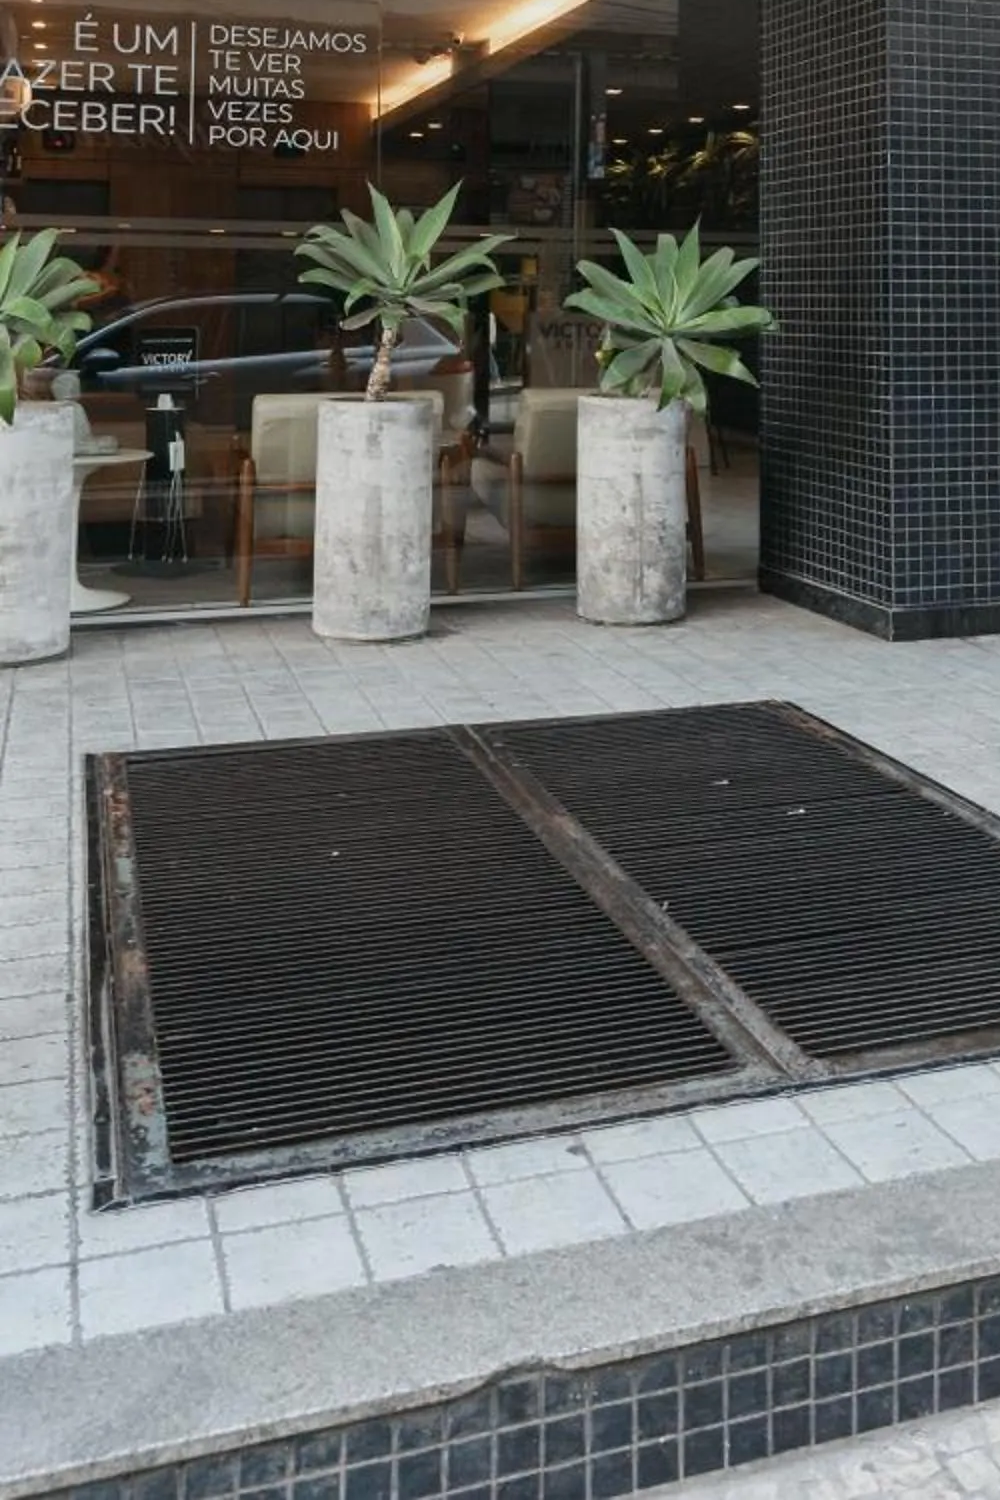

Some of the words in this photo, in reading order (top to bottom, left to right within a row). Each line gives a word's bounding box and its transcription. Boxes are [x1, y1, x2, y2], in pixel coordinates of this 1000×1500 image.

[75, 13, 98, 51] É
[113, 23, 178, 55] UM
[210, 24, 367, 53] DESEJAMOS
[208, 49, 241, 71] TE
[248, 51, 301, 74] VER
[128, 63, 178, 95] TE
[208, 75, 305, 99] MUITAS
[207, 99, 293, 123] VEZES
[208, 125, 266, 148] POR
[273, 128, 338, 151] AQUI
[141, 349, 193, 365] VICTORY
